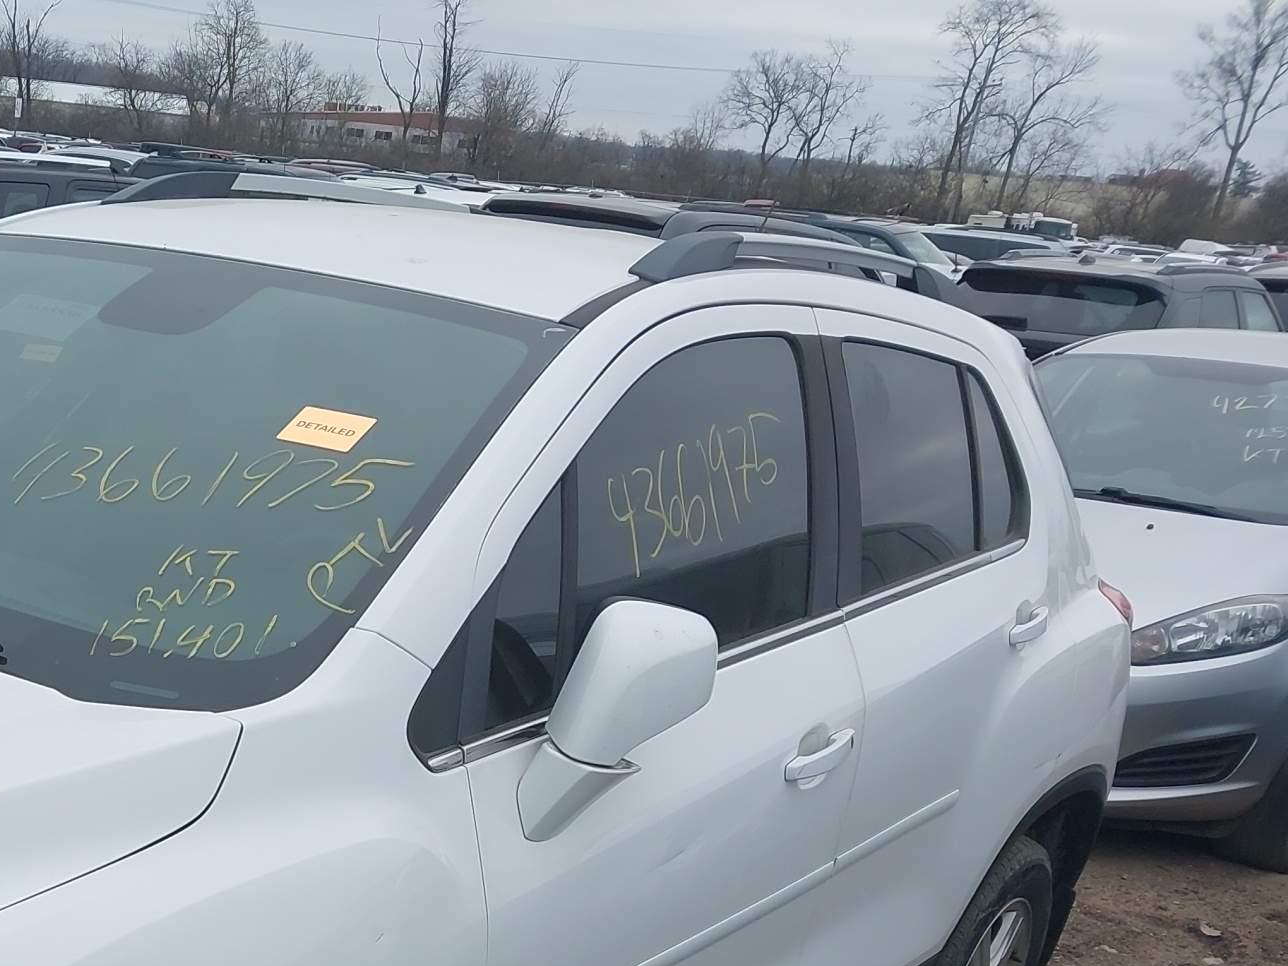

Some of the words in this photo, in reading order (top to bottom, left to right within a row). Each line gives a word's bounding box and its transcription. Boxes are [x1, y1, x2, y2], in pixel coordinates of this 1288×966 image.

[295, 419, 356, 438] DETAILED
[12, 442, 416, 510] 43661975
[608, 413, 782, 578] 43661975
[158, 544, 239, 576] KT
